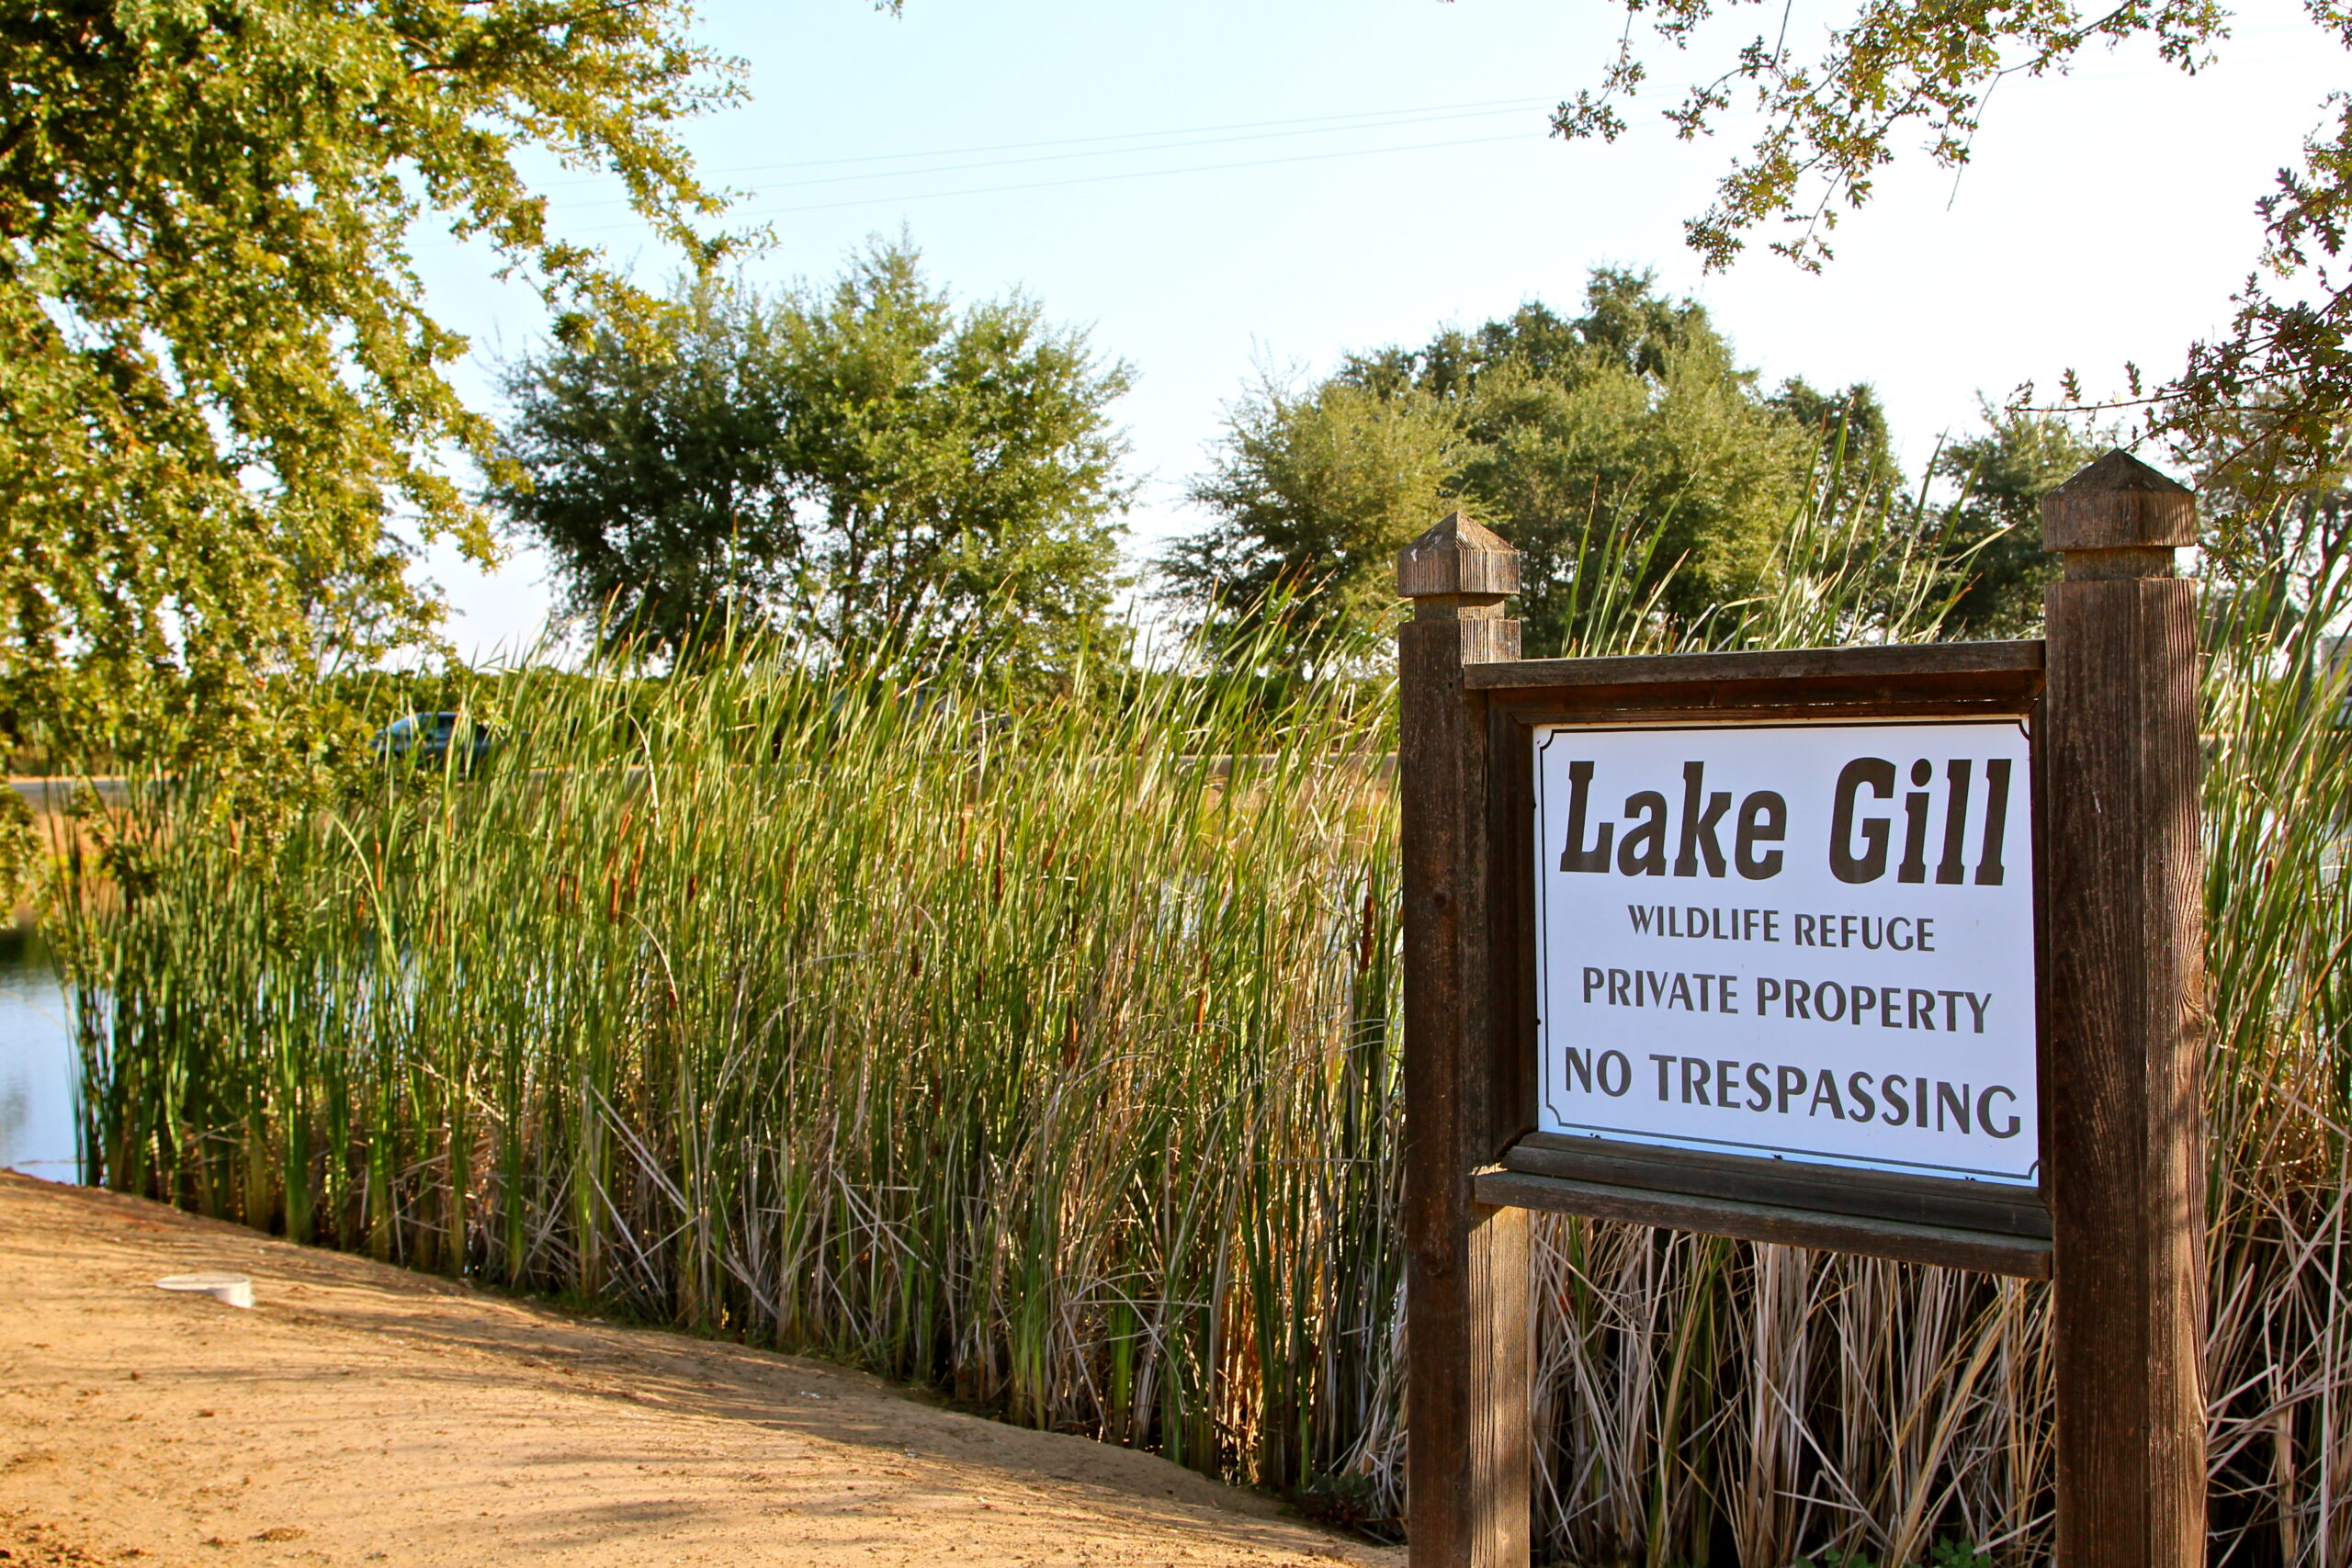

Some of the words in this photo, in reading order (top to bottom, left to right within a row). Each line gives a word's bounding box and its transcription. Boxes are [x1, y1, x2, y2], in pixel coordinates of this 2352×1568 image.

[1560, 761, 1787, 880] Lake
[1829, 757, 2011, 886] Gill
[1628, 905, 1780, 942] WILDLIFE
[1795, 914, 1935, 952] REFUGE
[1583, 967, 1738, 1014] PRIVATE
[1758, 977, 1992, 1033] PROPERTY
[1566, 1047, 1632, 1097] NO
[1649, 1054, 2020, 1138] TRESPASSING
